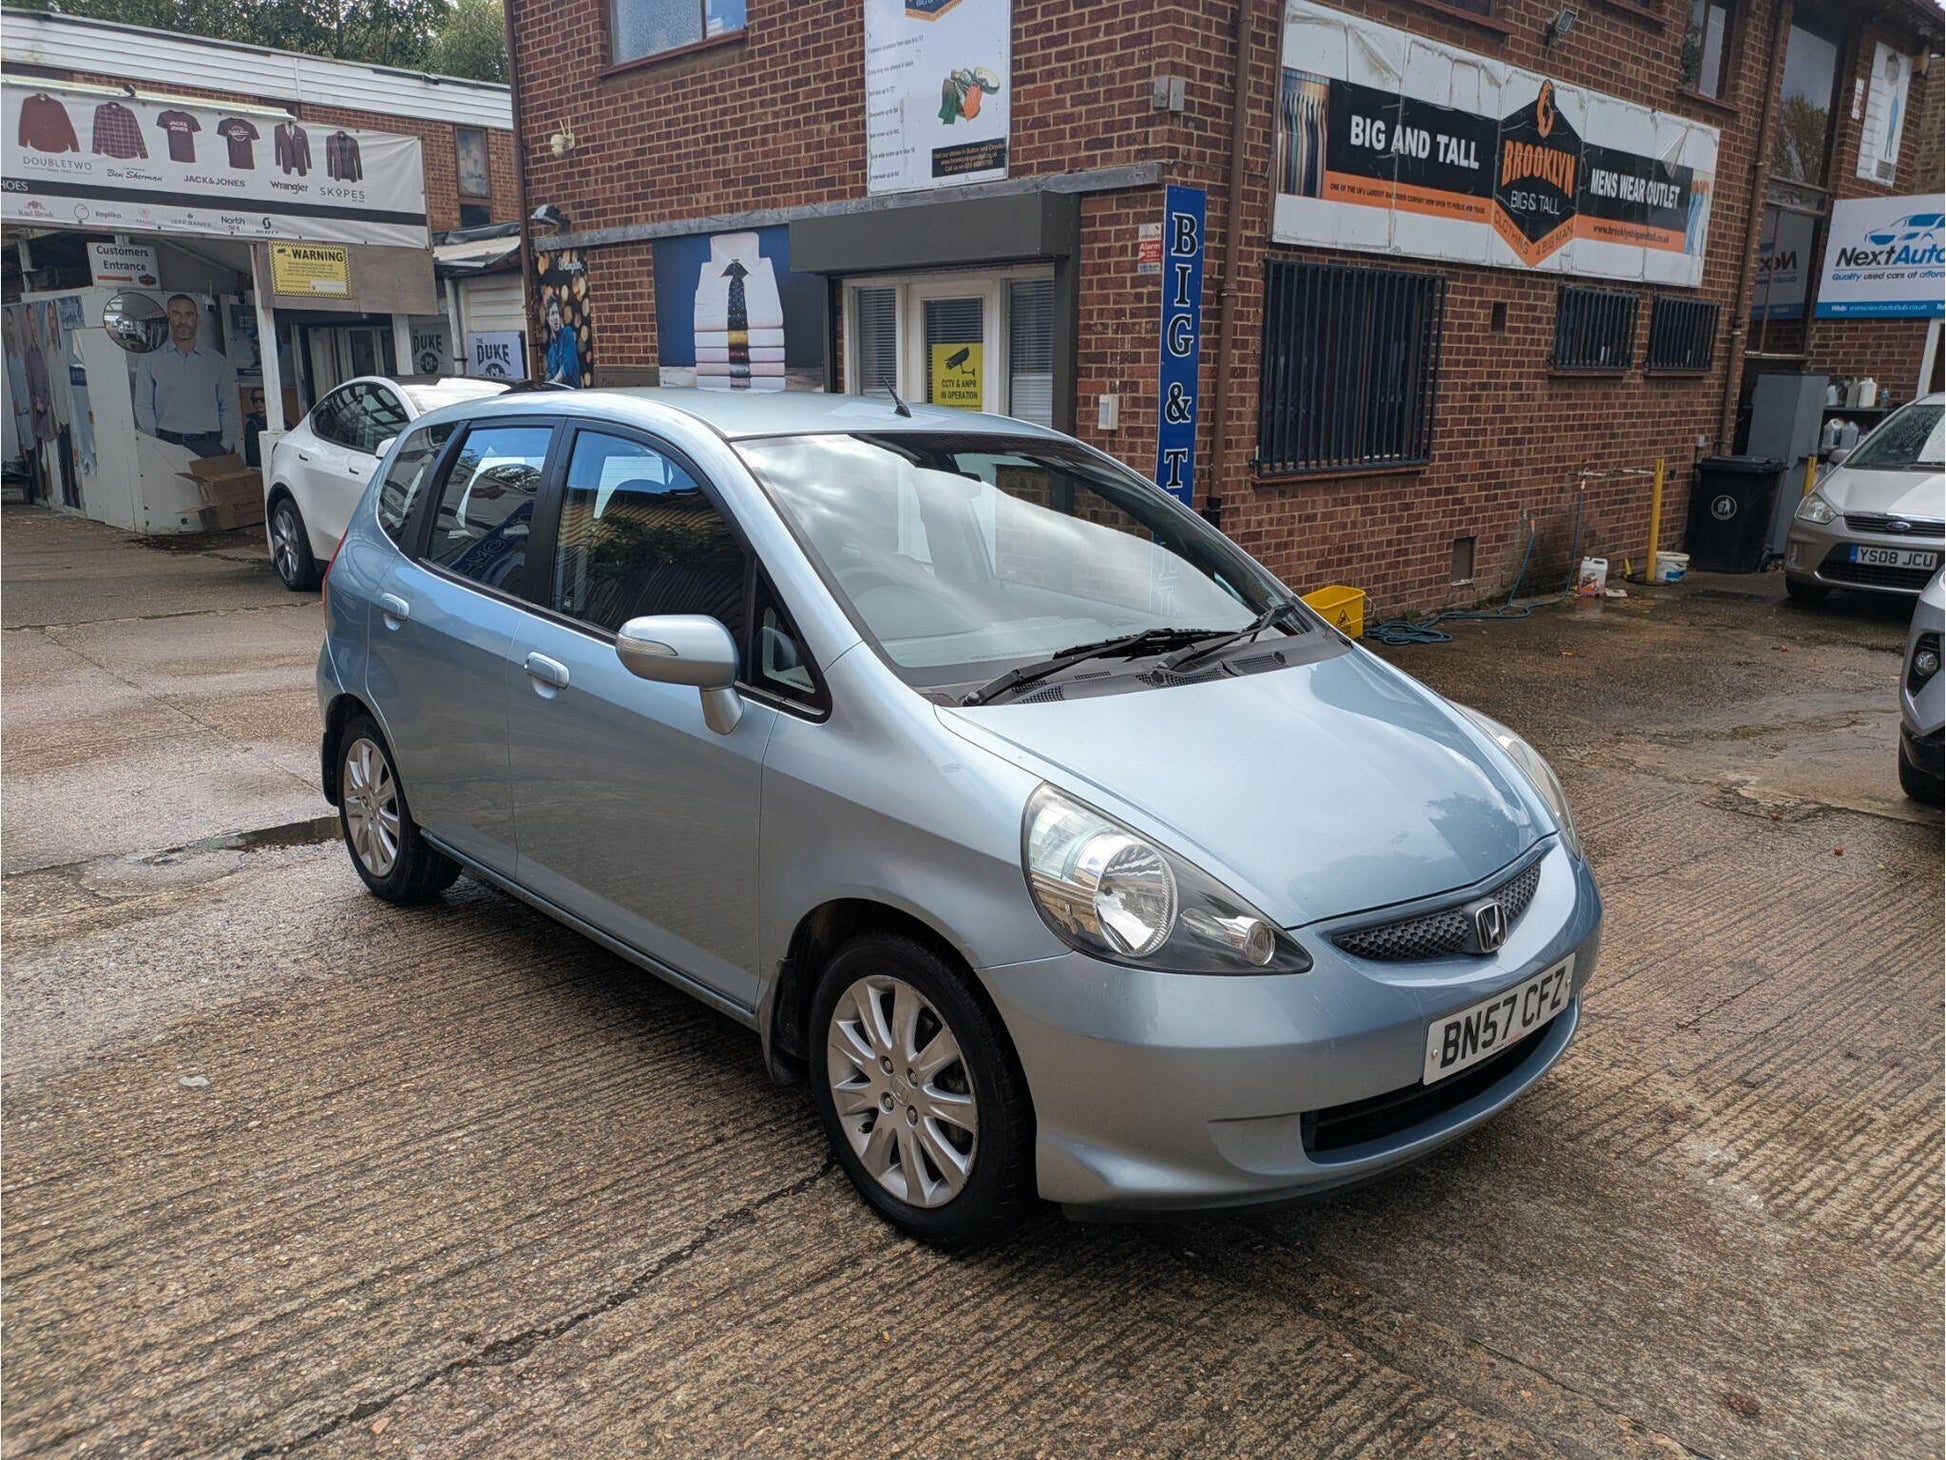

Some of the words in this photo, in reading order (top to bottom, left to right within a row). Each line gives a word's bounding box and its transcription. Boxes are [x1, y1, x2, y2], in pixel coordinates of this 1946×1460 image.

[1350, 114, 1386, 150] BIG
[1391, 124, 1430, 159] AND
[1437, 134, 1480, 170] TALL
[23, 156, 92, 170] DOUBLETWO
[1501, 140, 1575, 199] BROOKLYN
[107, 169, 123, 178] Ben
[126, 171, 163, 181] Sherman
[184, 175, 246, 188] JACK&JONES
[270, 180, 309, 195] Wrangler
[320, 187, 365, 199] SKOPES
[1590, 168, 1619, 198] MENS
[1620, 174, 1645, 203] WEAR
[1647, 180, 1680, 210] OUTLET
[1539, 195, 1560, 215] TALL
[221, 216, 246, 226] North
[1493, 211, 1529, 255] CLOTHING
[1554, 223, 1574, 243] MAN
[97, 246, 149, 257] Customers
[292, 249, 344, 262] WARNING
[103, 260, 147, 271] Entrance
[1166, 211, 1199, 358] BIG
[1832, 272, 1861, 281] Quality
[413, 334, 443, 356] DUKE
[476, 344, 511, 366] DUKE
[942, 379, 954, 388] CCTV
[961, 379, 977, 388] ANPR
[941, 391, 947, 399] IN
[947, 391, 978, 400] OPERATION
[1164, 381, 1192, 424] &
[1860, 549, 1898, 564] YS08
[1903, 553, 1934, 567] JCU
[1440, 994, 1517, 1069] BN57
[1522, 966, 1566, 1028] CFZ
